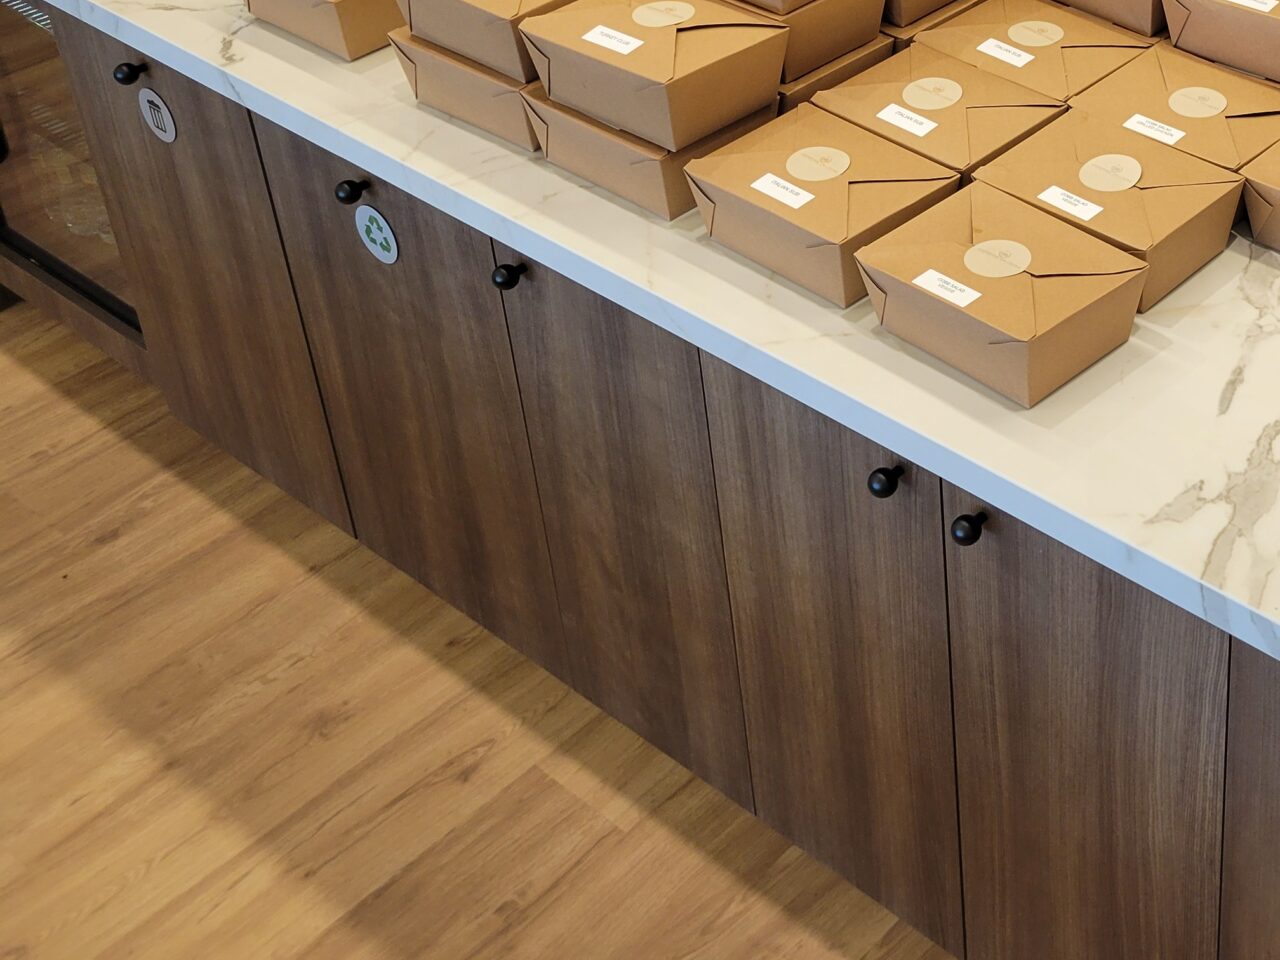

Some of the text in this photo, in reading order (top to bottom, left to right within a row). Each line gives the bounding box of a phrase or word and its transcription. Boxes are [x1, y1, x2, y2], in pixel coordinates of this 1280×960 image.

[770, 180, 802, 198] ITALIAN SUB
[949, 283, 967, 294] SALAD
